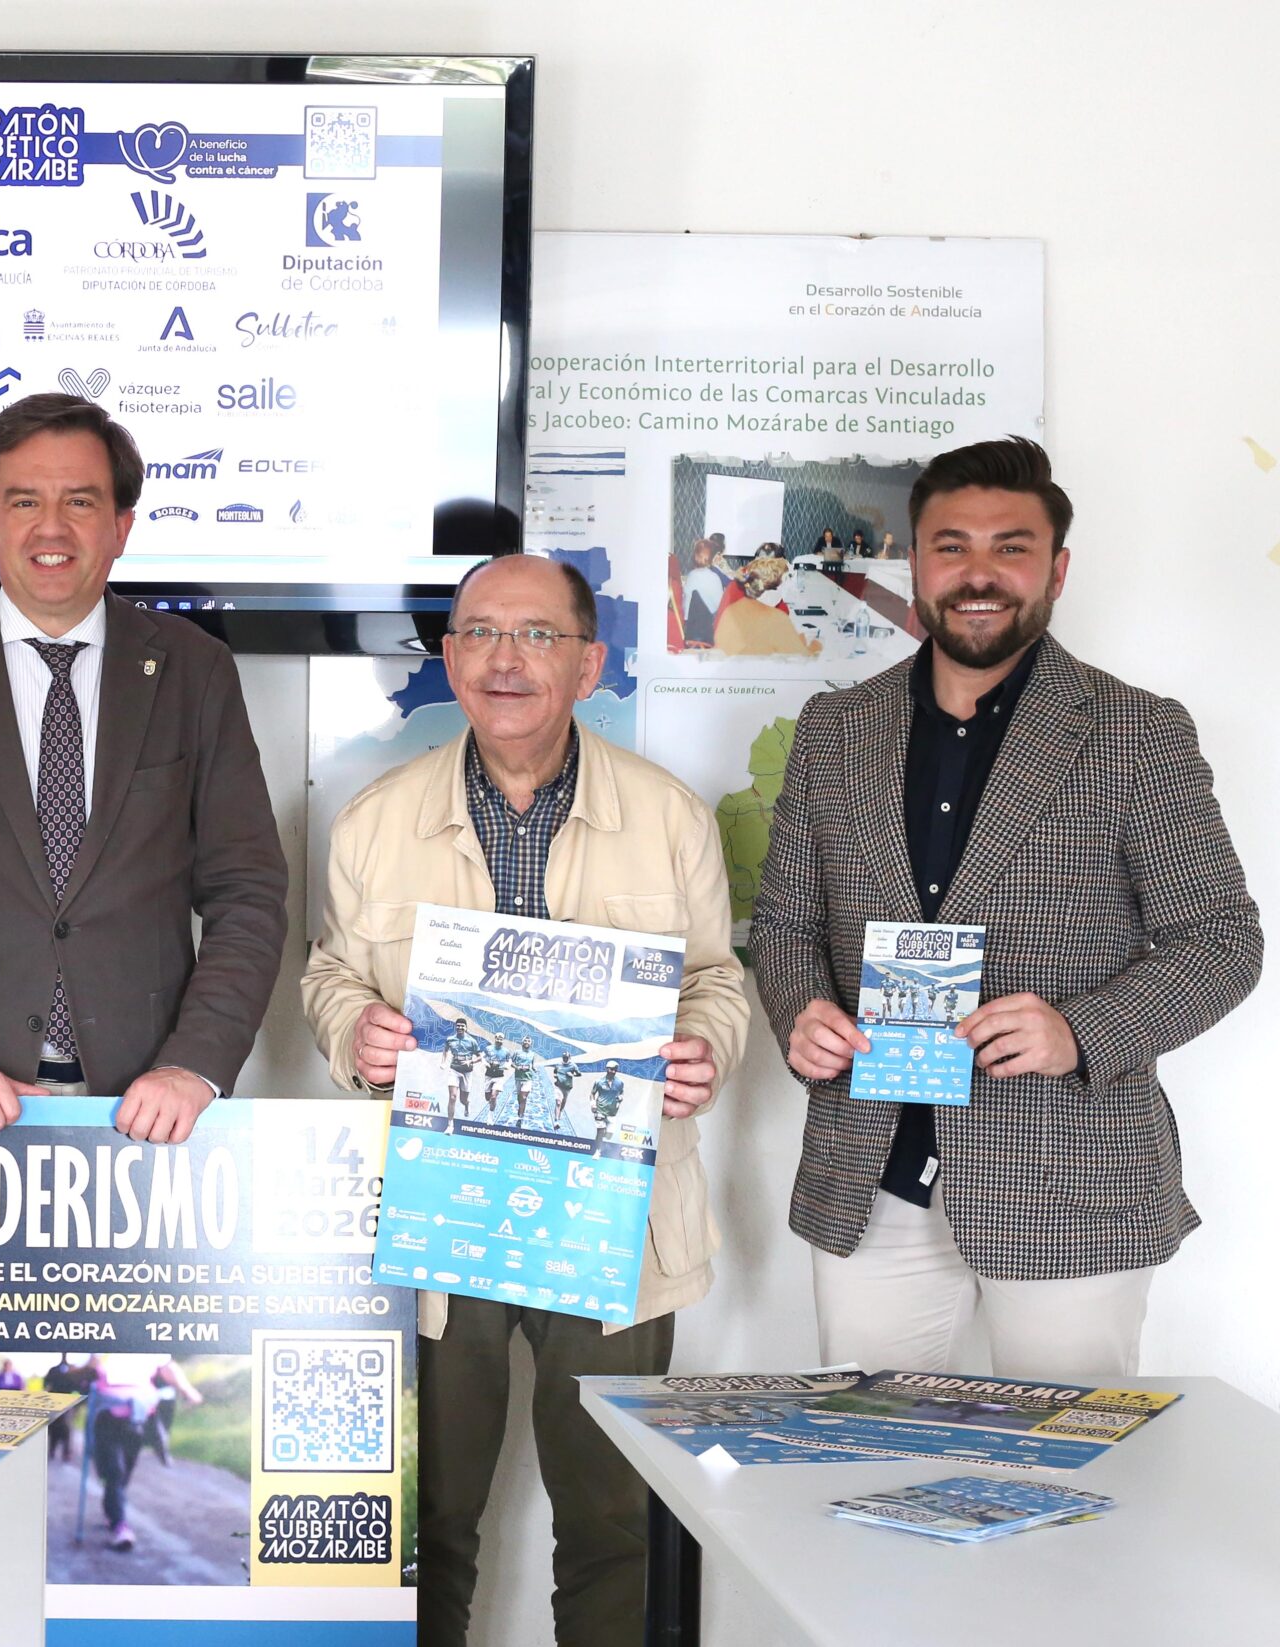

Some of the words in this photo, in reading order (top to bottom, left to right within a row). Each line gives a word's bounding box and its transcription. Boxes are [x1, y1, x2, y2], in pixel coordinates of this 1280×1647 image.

[189, 139, 198, 149] A
[199, 139, 247, 149] beneficio
[189, 152, 203, 162] de
[205, 152, 215, 162] la
[216, 152, 247, 162] lucha
[189, 165, 223, 175] contra
[225, 165, 236, 175] el
[238, 164, 275, 176] cáncer
[93, 239, 175, 263] CÓRDOBA
[283, 255, 382, 274] Diputación
[82, 280, 146, 291] DIPUTACIÓN
[148, 281, 162, 291] DE
[165, 280, 216, 291] CÓRDOBA
[281, 275, 303, 291] de
[309, 275, 383, 291] Córdoba
[806, 283, 883, 298] Desarrollo
[886, 285, 963, 299] Sostenible
[137, 344, 161, 352] Junta
[163, 344, 174, 352] de
[175, 344, 217, 352] Andalucía
[655, 355, 804, 375] Interterritorial
[813, 361, 857, 380] para
[864, 356, 881, 376] el
[890, 358, 994, 378] Desarrollo
[118, 383, 181, 398] vázquez
[217, 377, 297, 410] saile
[558, 385, 571, 405] y
[579, 382, 692, 402] Económico
[699, 382, 723, 402] de
[731, 383, 758, 403] las
[765, 385, 868, 404] Comarcas
[875, 386, 986, 406] Vinculadas
[119, 400, 202, 415] fisioterapia
[541, 409, 631, 433] Jacobeo:
[638, 412, 719, 431] Camino
[727, 412, 828, 432] Mozárabe
[835, 413, 859, 433] de
[866, 415, 954, 440] Santiago
[154, 507, 194, 519] BORGES
[219, 511, 261, 520] MONTEOLIVA
[429, 919, 450, 929] Doña
[452, 922, 480, 934] Mencía
[899, 930, 951, 943] MARATÓN
[490, 932, 610, 965] MARATÓN
[646, 952, 662, 962] 28
[632, 960, 674, 974] Marzo
[636, 970, 667, 983] 2026
[405, 1114, 433, 1128] 52K
[461, 1125, 591, 1151] maratonsubbeticomozarabe.com
[621, 1147, 643, 1159] 25K
[13, 1322, 30, 1339] A
[34, 1321, 116, 1340] CABRA
[145, 1322, 173, 1341] 12
[178, 1322, 219, 1342] KM
[886, 1373, 1080, 1401] SENDERISMO
[266, 1496, 387, 1521] MARATÓN
[265, 1517, 387, 1541] SUBBÉTICO
[266, 1537, 387, 1559] MOZÁRABE
